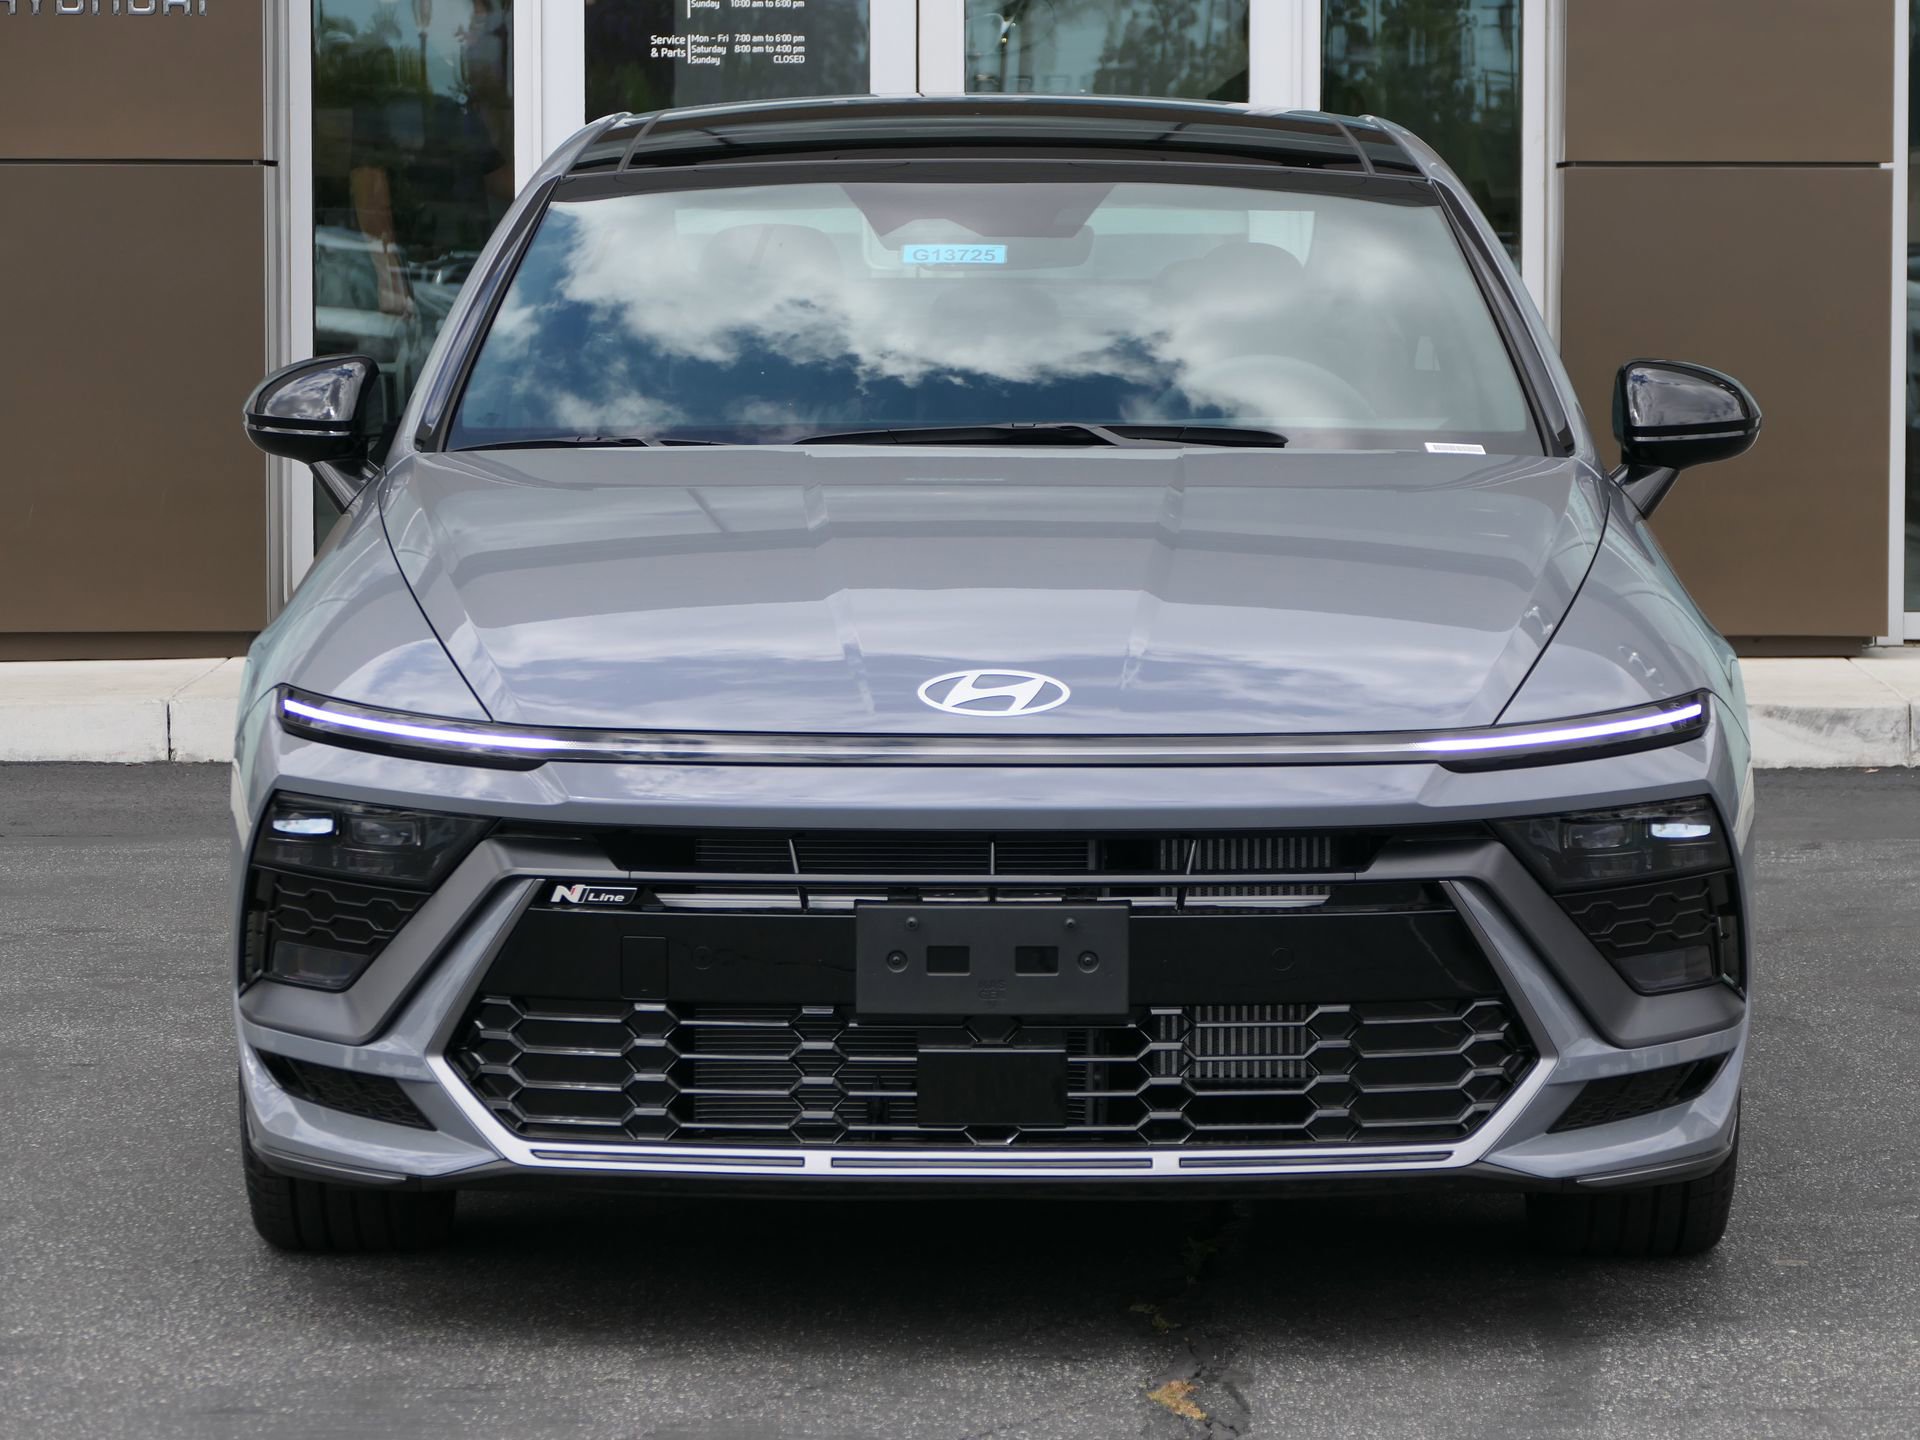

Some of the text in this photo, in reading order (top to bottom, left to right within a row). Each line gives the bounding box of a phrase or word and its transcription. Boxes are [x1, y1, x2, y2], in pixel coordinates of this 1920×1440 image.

[691, 0, 720, 9] Sunday
[731, 0, 750, 8] 10:00
[765, 0, 774, 8] to
[775, 0, 791, 8] 6:00
[792, 0, 805, 9] pm
[650, 34, 686, 45] Service
[691, 34, 709, 42] Mon
[717, 34, 729, 42] Fri
[735, 34, 751, 42] 7:00
[765, 34, 774, 42] to
[775, 34, 792, 42] 6:00
[792, 35, 805, 44] pm
[650, 47, 686, 58] & Parts
[691, 44, 727, 55] Saturday
[734, 44, 751, 53] 8:00
[765, 45, 774, 53] to
[775, 44, 792, 53] 4:00
[792, 46, 805, 54] pm
[691, 55, 805, 66] Sunday CLOSED
[912, 248, 996, 262] G13725
[550, 884, 625, 904] N Line
